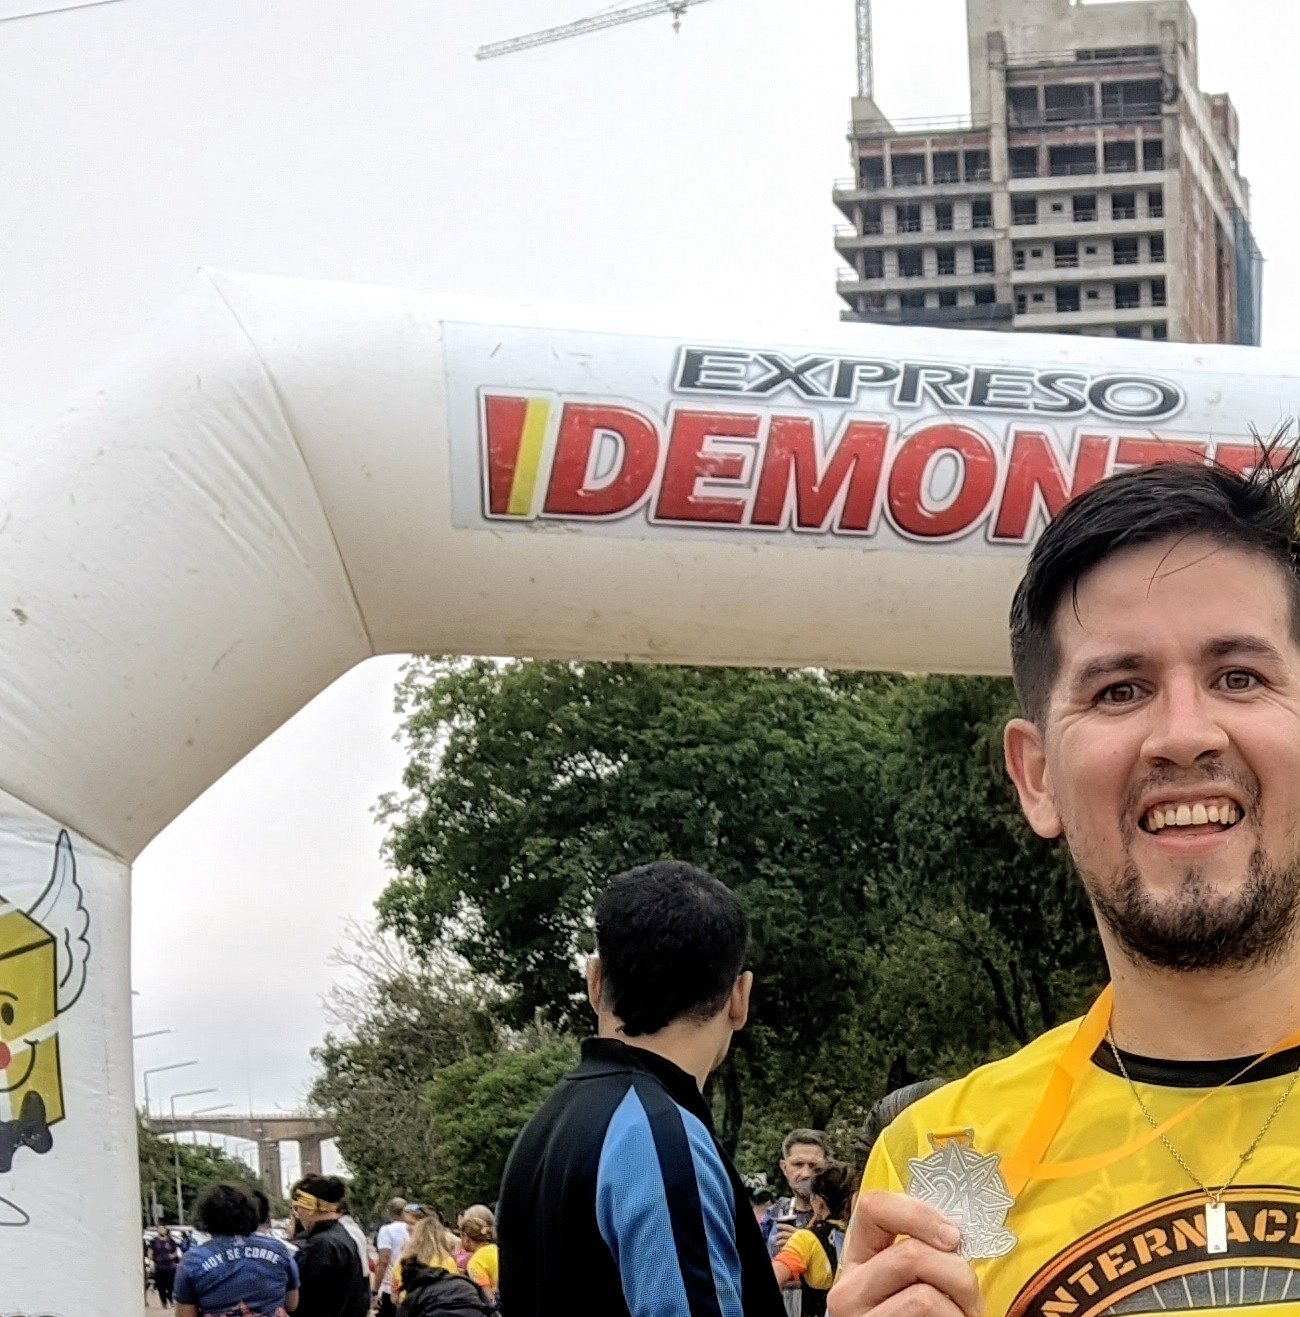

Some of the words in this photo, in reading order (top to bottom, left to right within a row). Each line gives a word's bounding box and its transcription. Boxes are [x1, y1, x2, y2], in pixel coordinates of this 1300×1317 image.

[676, 347, 1182, 418] EXPRESO
[545, 402, 1300, 542] DEMON
[202, 1254, 223, 1271] HOY
[226, 1247, 241, 1261] SE
[244, 1247, 280, 1264] CORRE
